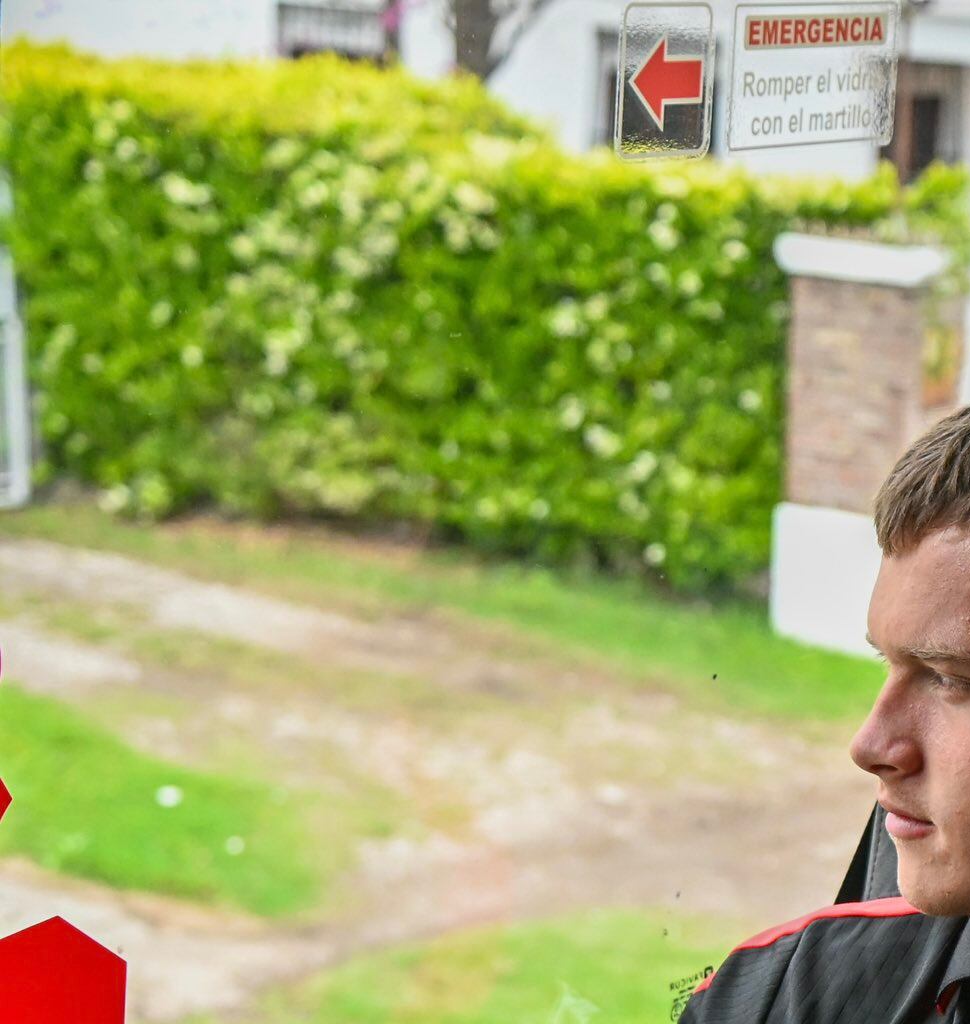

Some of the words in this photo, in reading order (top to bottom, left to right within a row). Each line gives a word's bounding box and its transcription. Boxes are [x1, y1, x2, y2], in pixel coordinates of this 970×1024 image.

[748, 16, 884, 46] EMERGENCIA
[743, 71, 812, 102] Romper
[817, 67, 831, 92] el
[751, 113, 782, 137] con
[789, 108, 803, 133] el
[809, 104, 872, 132] martillo
